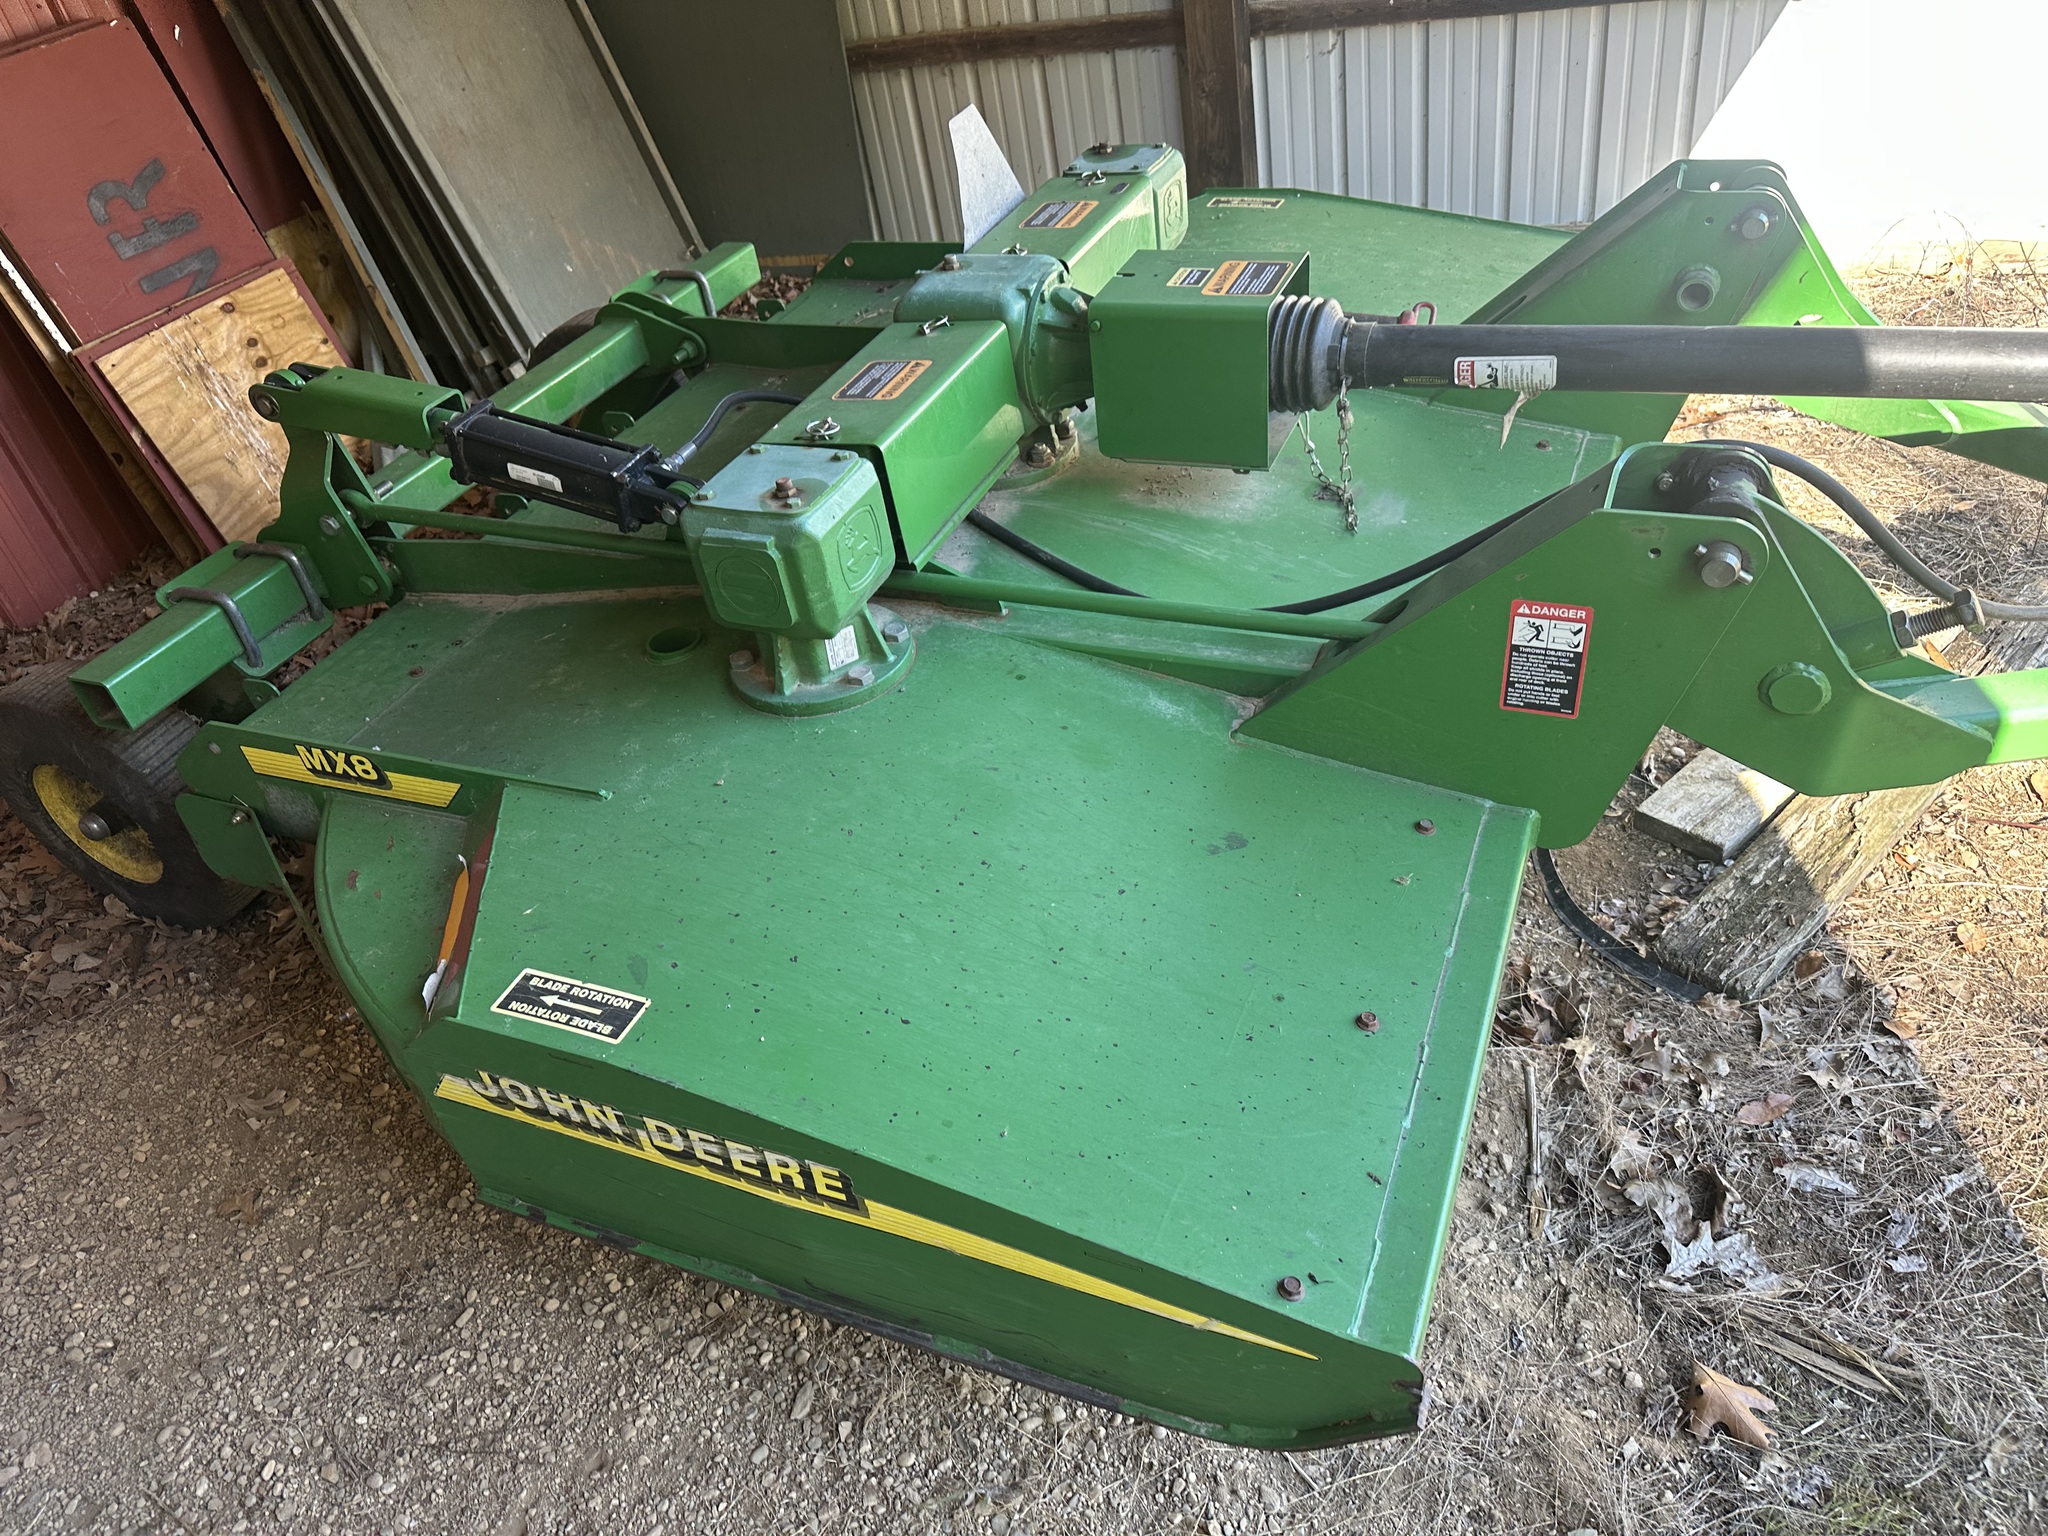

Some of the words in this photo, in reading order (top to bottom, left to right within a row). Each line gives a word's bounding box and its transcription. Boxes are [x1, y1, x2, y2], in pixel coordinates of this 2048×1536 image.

[1459, 361, 1472, 386] GER
[1532, 605, 1586, 619] DANGER
[295, 744, 378, 781] MX8
[529, 977, 571, 993] BLADE
[570, 985, 634, 1010] ROTATION
[508, 1000, 571, 1024] ROTATION
[570, 1017, 614, 1035] BLADE
[469, 1069, 628, 1140] JOHN
[641, 1114, 848, 1202] DEERE
